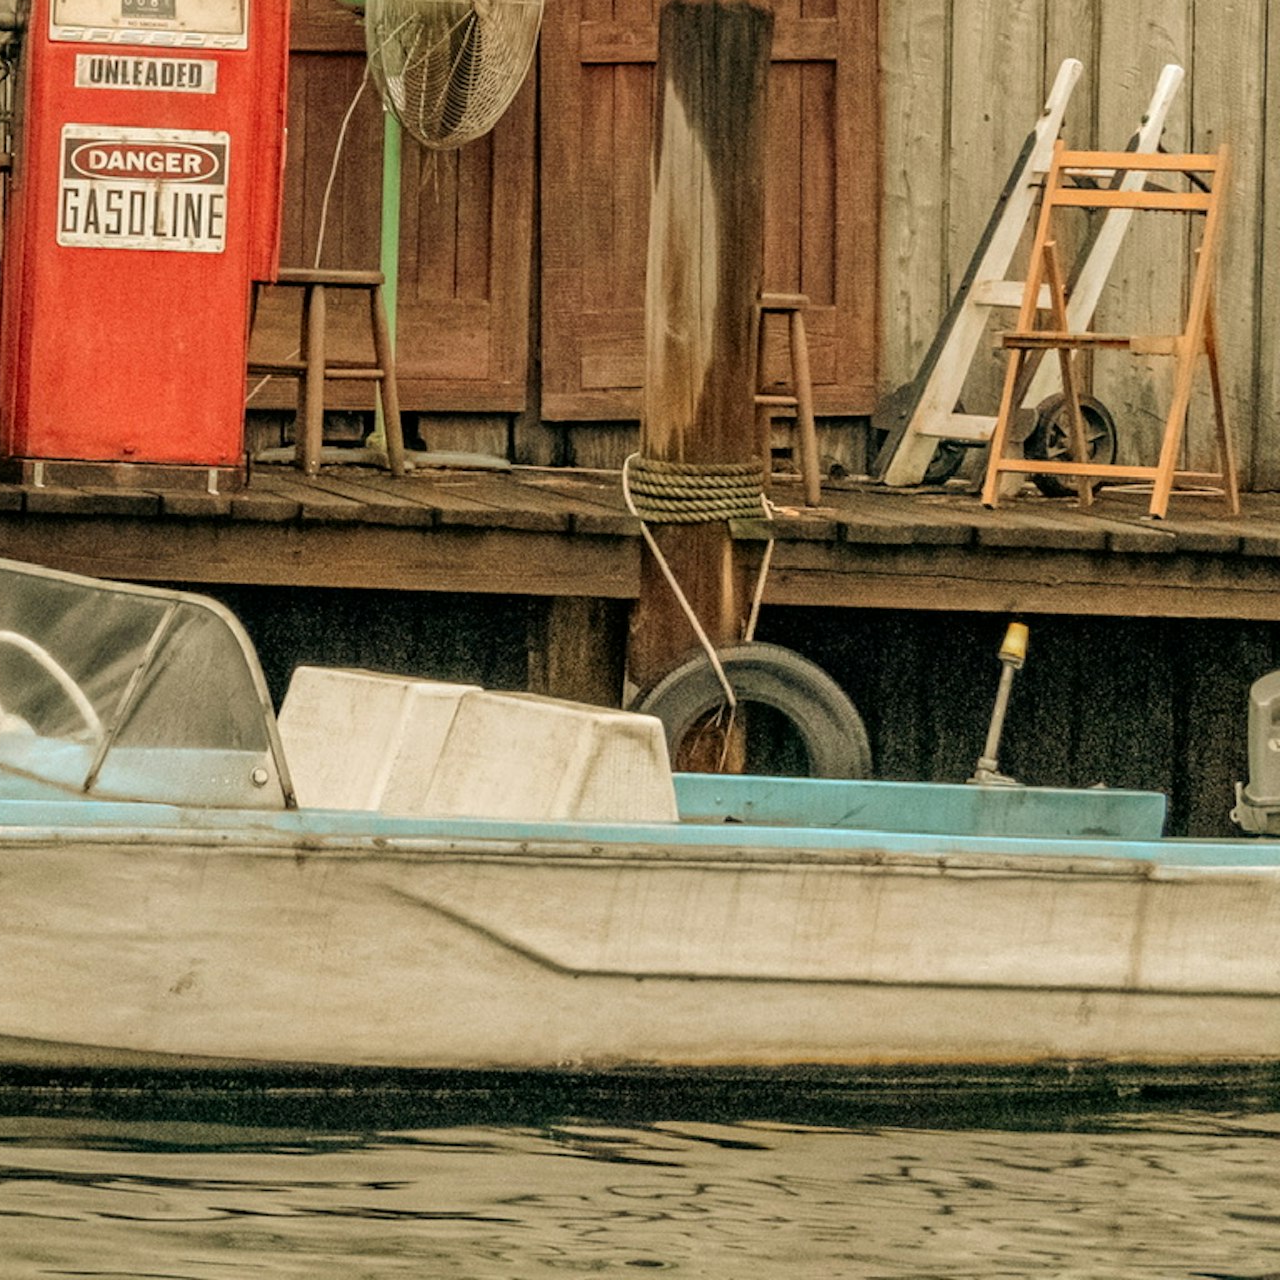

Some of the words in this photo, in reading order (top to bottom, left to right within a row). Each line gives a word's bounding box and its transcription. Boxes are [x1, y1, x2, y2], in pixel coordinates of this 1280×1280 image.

[90, 58, 203, 88] UNLEADED
[89, 150, 203, 174] DANGER
[61, 187, 224, 239] GASOLINE
